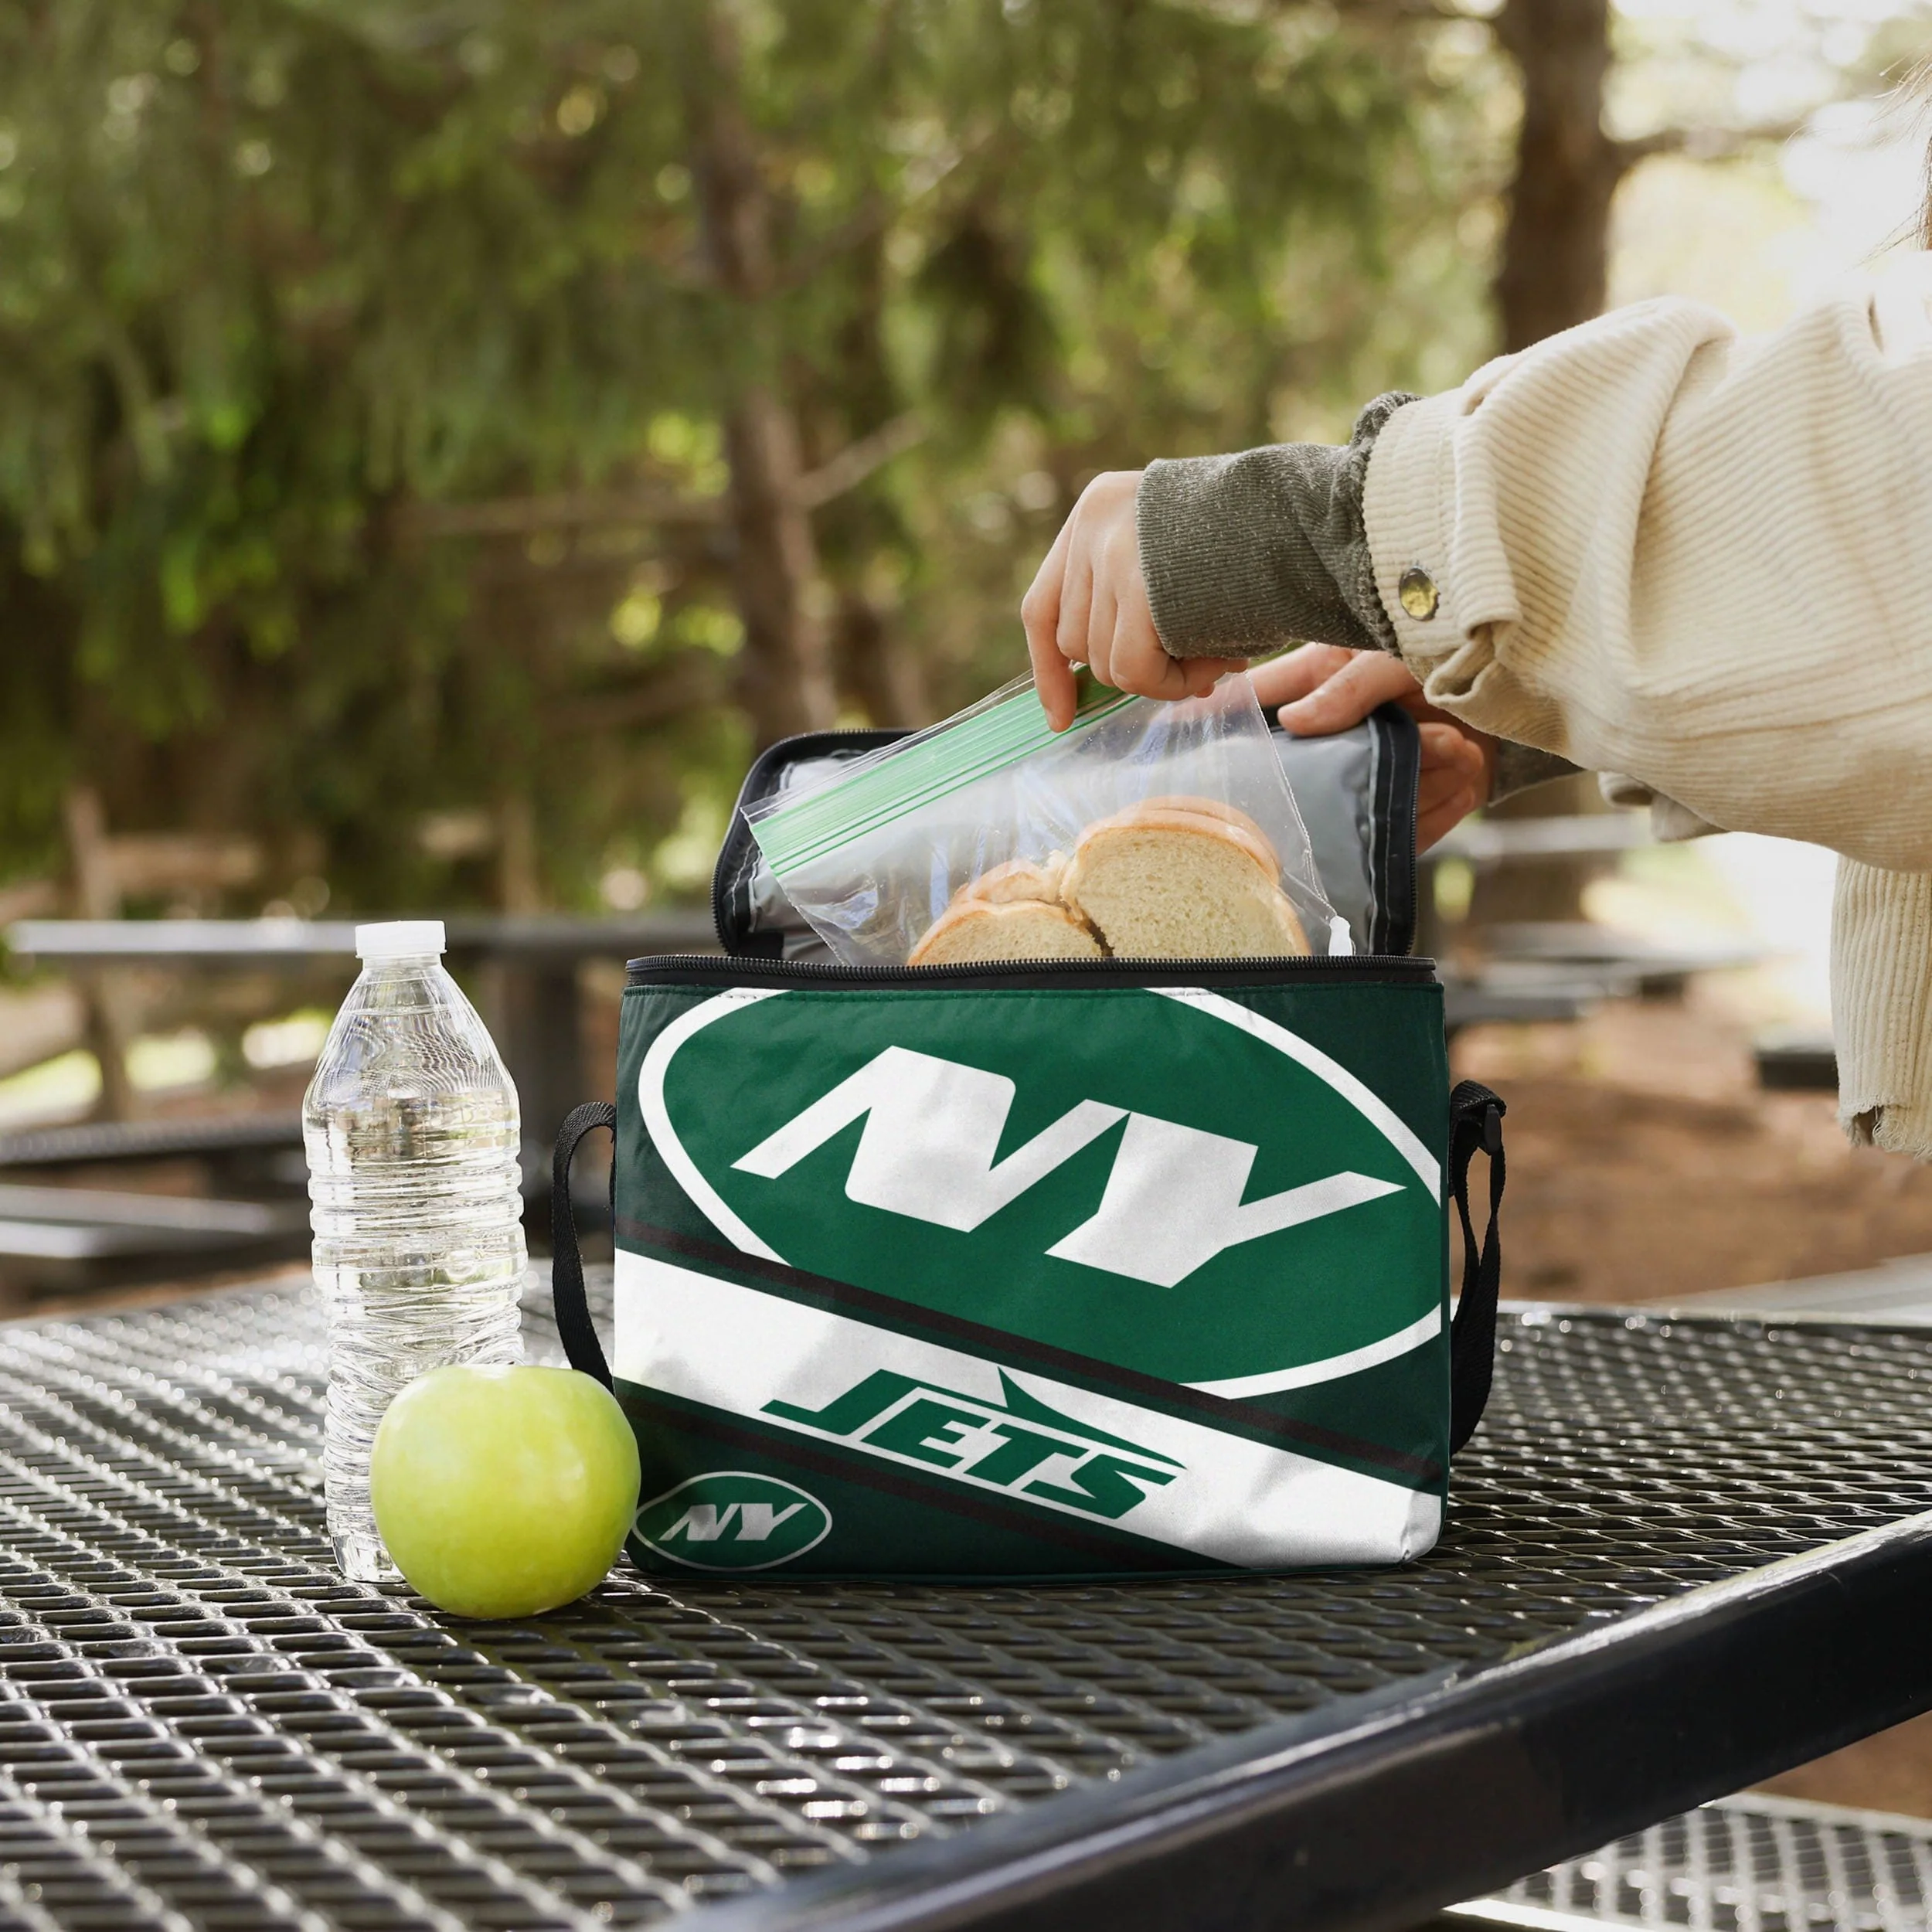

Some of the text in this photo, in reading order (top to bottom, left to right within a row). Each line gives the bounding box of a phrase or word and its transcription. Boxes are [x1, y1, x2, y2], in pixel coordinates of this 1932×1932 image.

[730, 1045, 1408, 1288] NY
[758, 1366, 1189, 1520] JETS
[658, 1502, 808, 1541] NY
